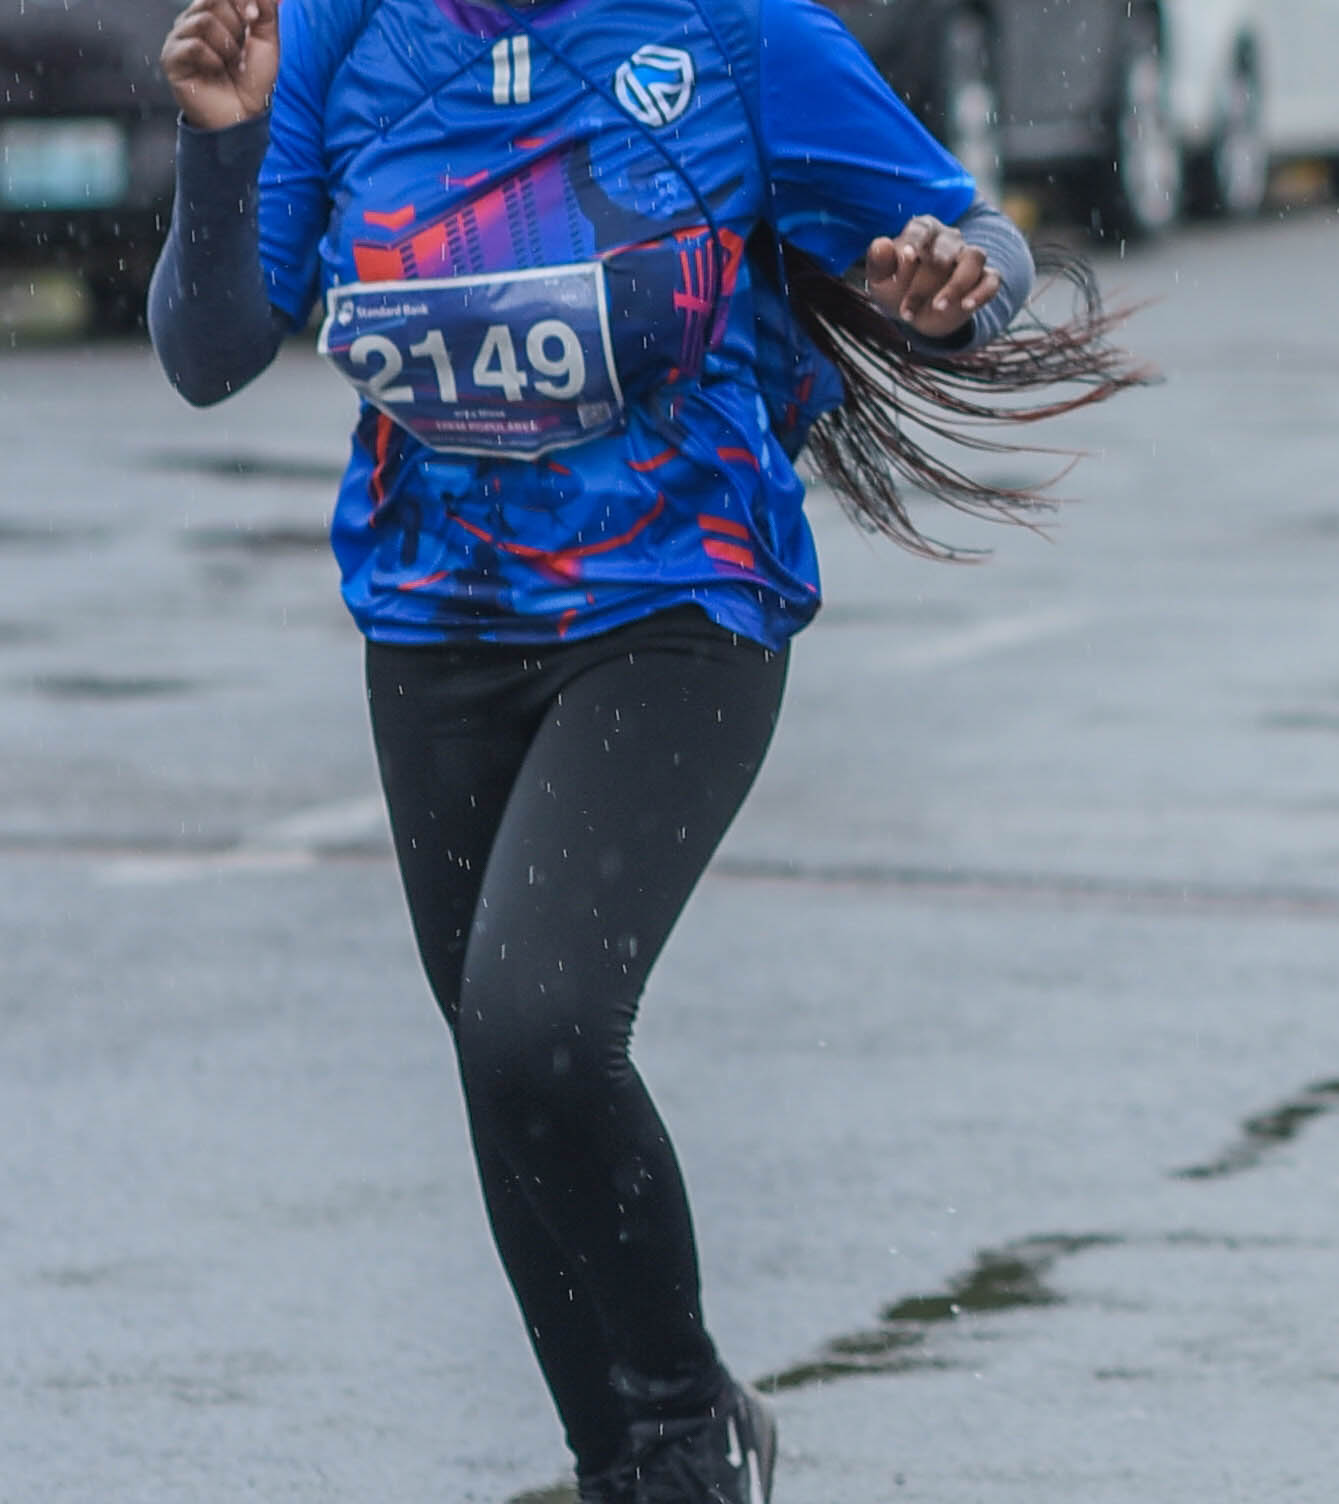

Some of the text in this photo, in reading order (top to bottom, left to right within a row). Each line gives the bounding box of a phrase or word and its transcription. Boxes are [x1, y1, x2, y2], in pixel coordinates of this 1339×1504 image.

[356, 302, 429, 319] Standard Bank
[350, 320, 585, 403] 2149
